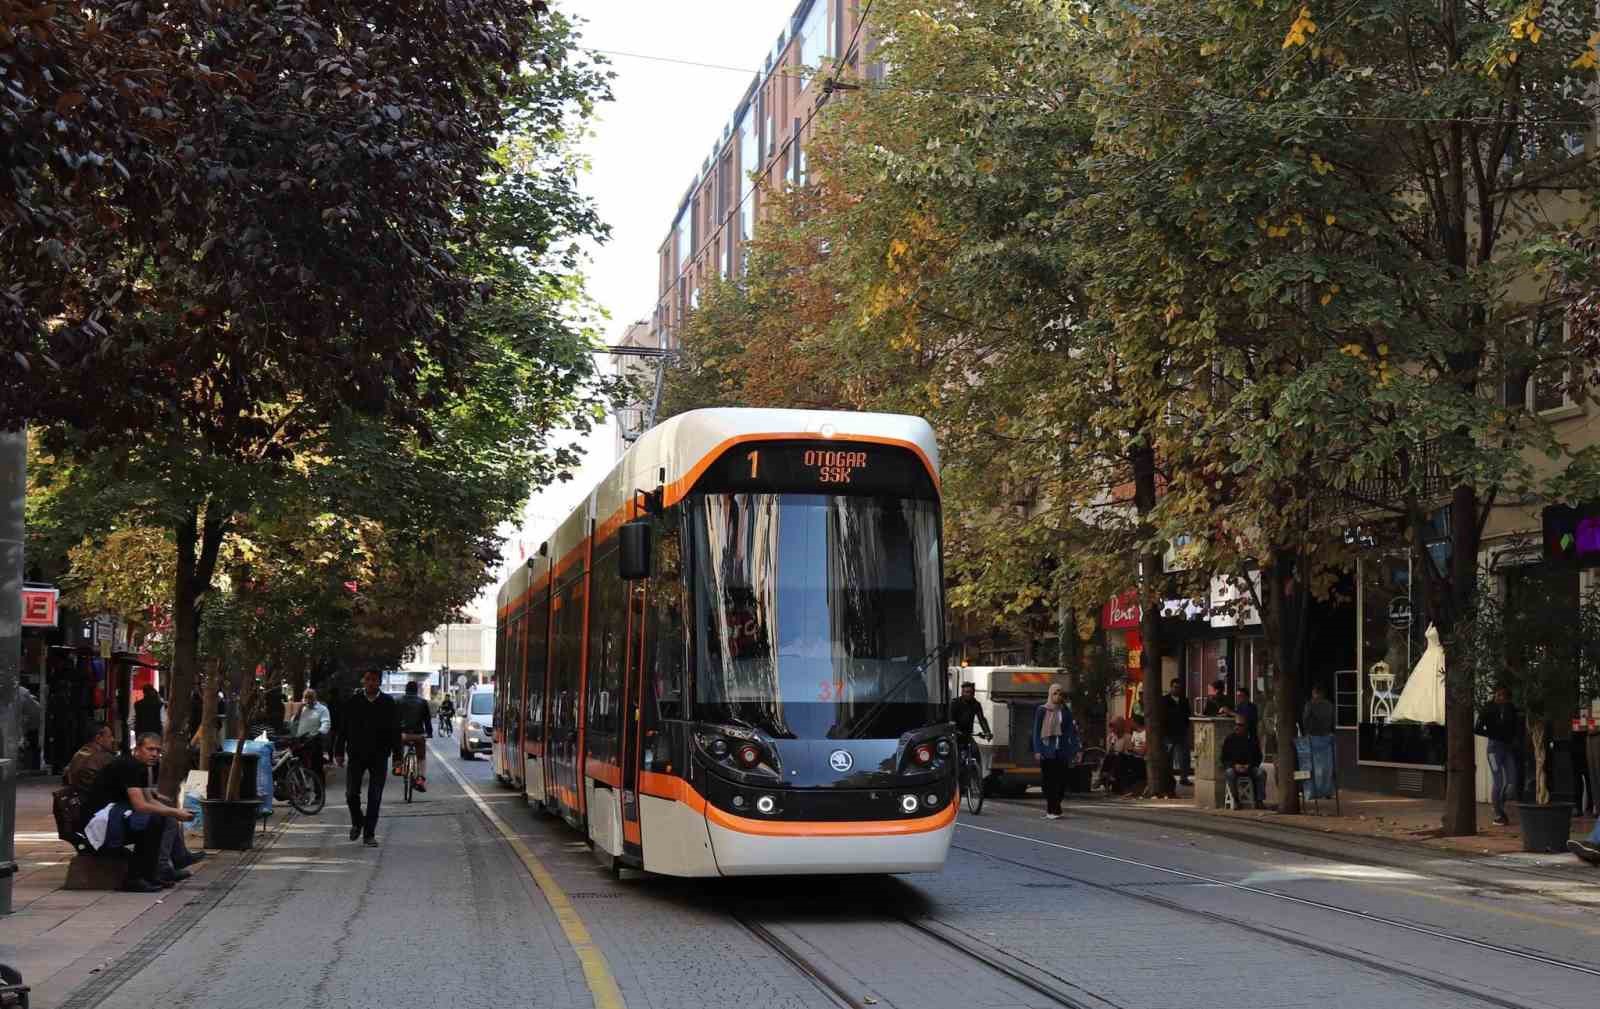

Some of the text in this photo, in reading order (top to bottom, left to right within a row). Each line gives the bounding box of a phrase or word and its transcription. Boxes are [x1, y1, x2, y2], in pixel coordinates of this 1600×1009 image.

[747, 450, 867, 479] 1 OTOGAR
[820, 467, 851, 483] SSK
